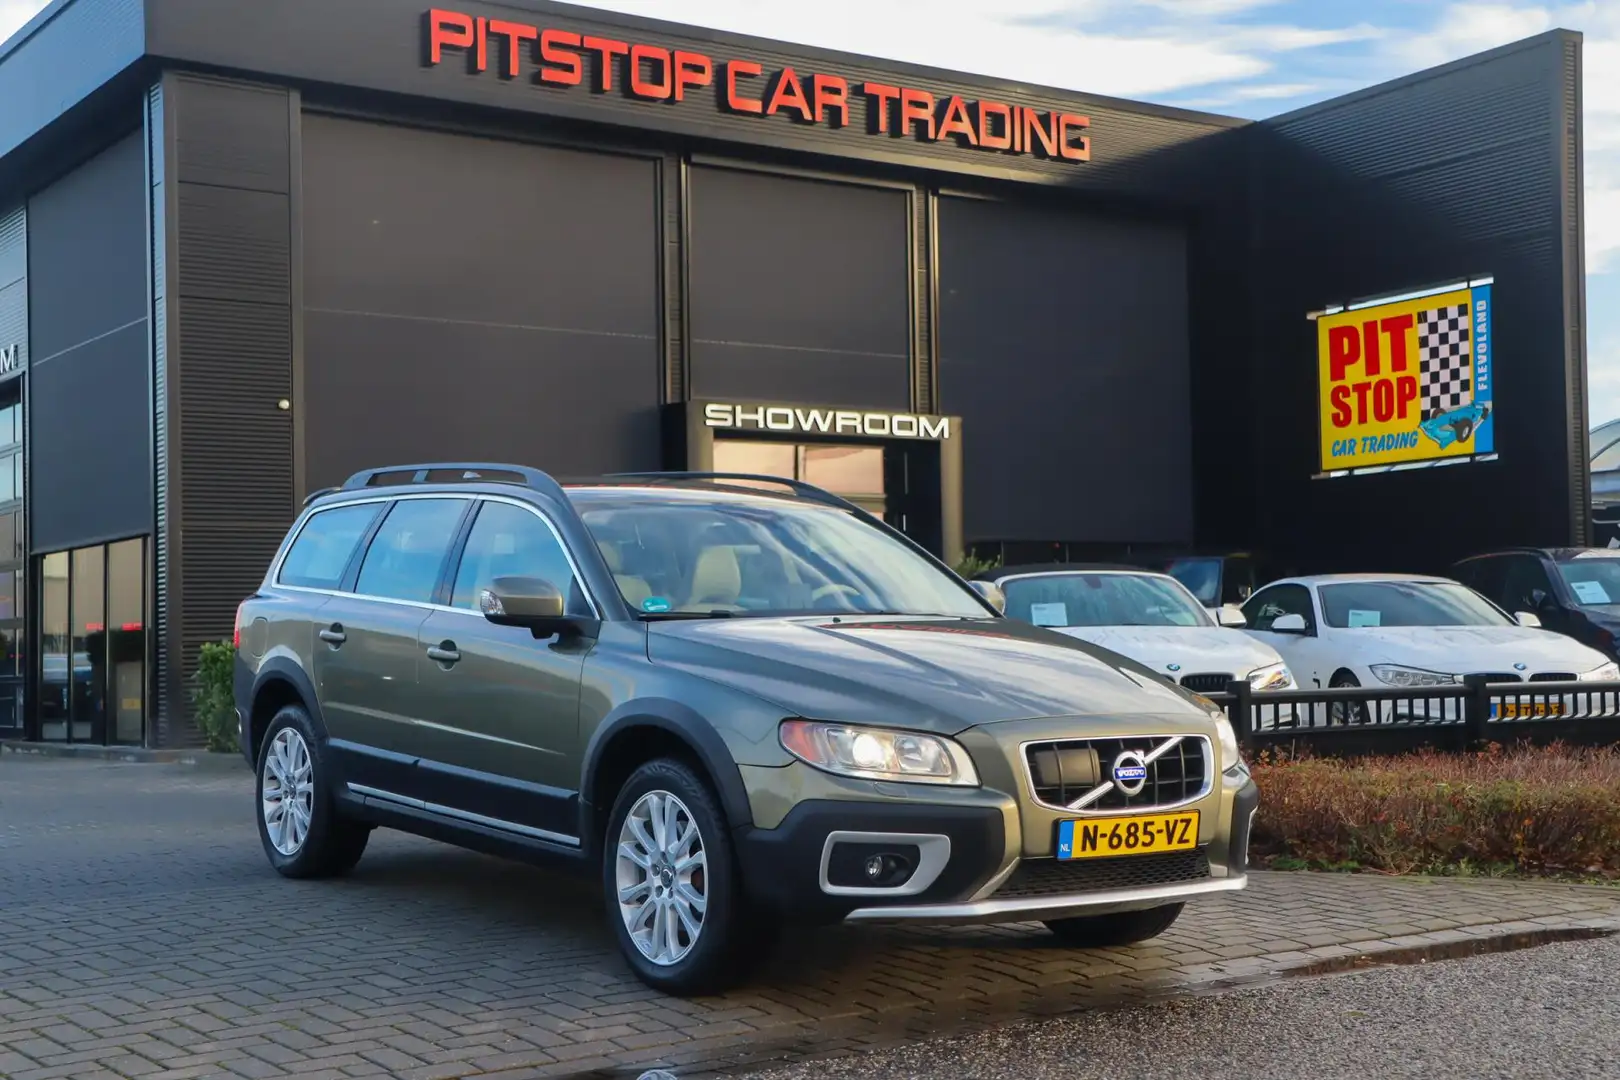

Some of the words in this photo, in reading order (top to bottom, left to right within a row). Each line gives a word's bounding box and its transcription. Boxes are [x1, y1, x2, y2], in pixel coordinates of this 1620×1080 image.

[430, 8, 713, 102] PITSTOP
[726, 59, 849, 127] CAR
[863, 82, 1091, 162] TRADING
[1328, 313, 1414, 382] PIT
[1476, 299, 1488, 391] FLEVOLAND
[704, 403, 950, 439] SHOWROOM
[1330, 375, 1417, 428] STOP
[1331, 439, 1357, 457] CAR
[1361, 430, 1419, 454] TRADING
[1060, 843, 1071, 852] NL
[1080, 818, 1192, 852] N-685-VZ
